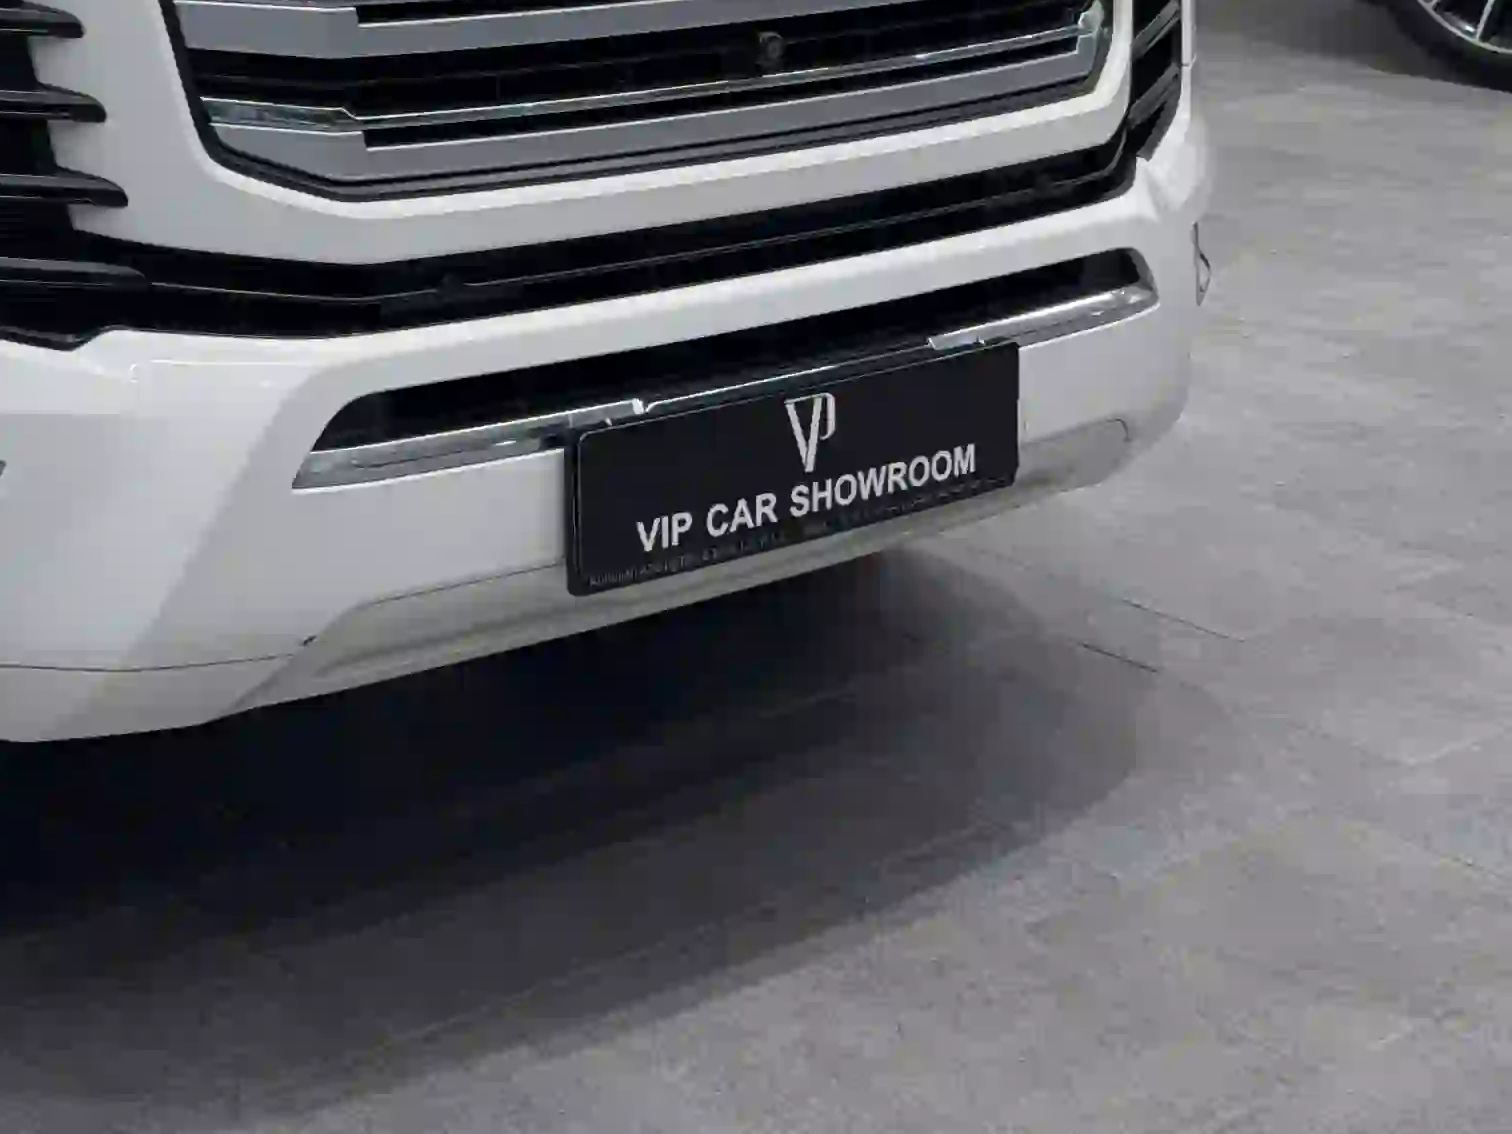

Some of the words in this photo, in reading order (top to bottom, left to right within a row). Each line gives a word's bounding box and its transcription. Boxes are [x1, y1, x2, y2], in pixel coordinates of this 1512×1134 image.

[636, 512, 693, 552] VIP
[706, 492, 778, 538] CAR
[789, 443, 976, 517] SHOWROOM
